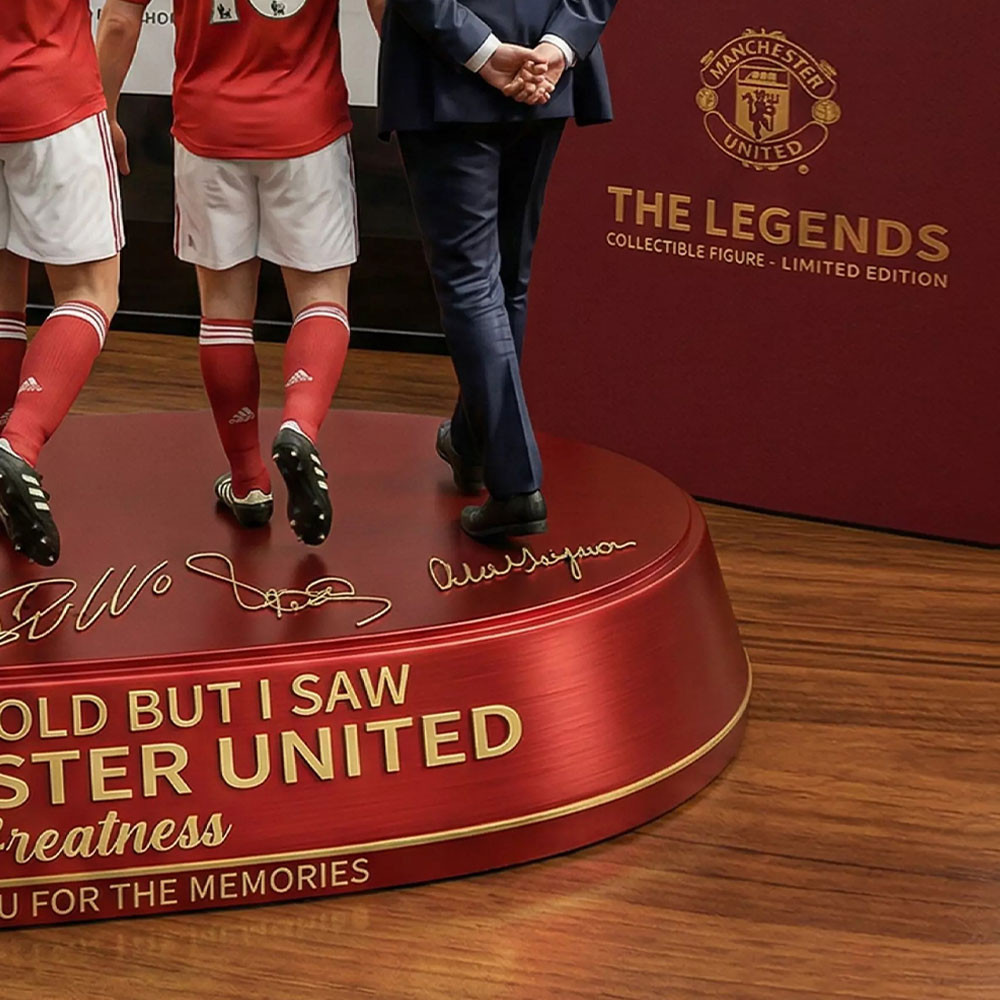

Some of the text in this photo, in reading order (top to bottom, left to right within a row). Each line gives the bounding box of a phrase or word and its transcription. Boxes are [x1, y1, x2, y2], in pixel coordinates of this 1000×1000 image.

[709, 40, 824, 91] MANCHESTER
[723, 133, 803, 161] UNITED
[607, 185, 951, 263] THE LEGENDS
[606, 231, 706, 259] COLLECTIBLE
[709, 246, 765, 268] FIGURE
[781, 257, 861, 279] LIMITED
[866, 266, 948, 289] EDITION
[128, 681, 241, 732] BUT
[259, 678, 272, 720] I
[291, 664, 410, 716] SAW
[218, 704, 524, 790] UNITED
[31, 885, 101, 917] FOR
[109, 878, 178, 911] THE
[189, 857, 371, 903] MEMORIES
